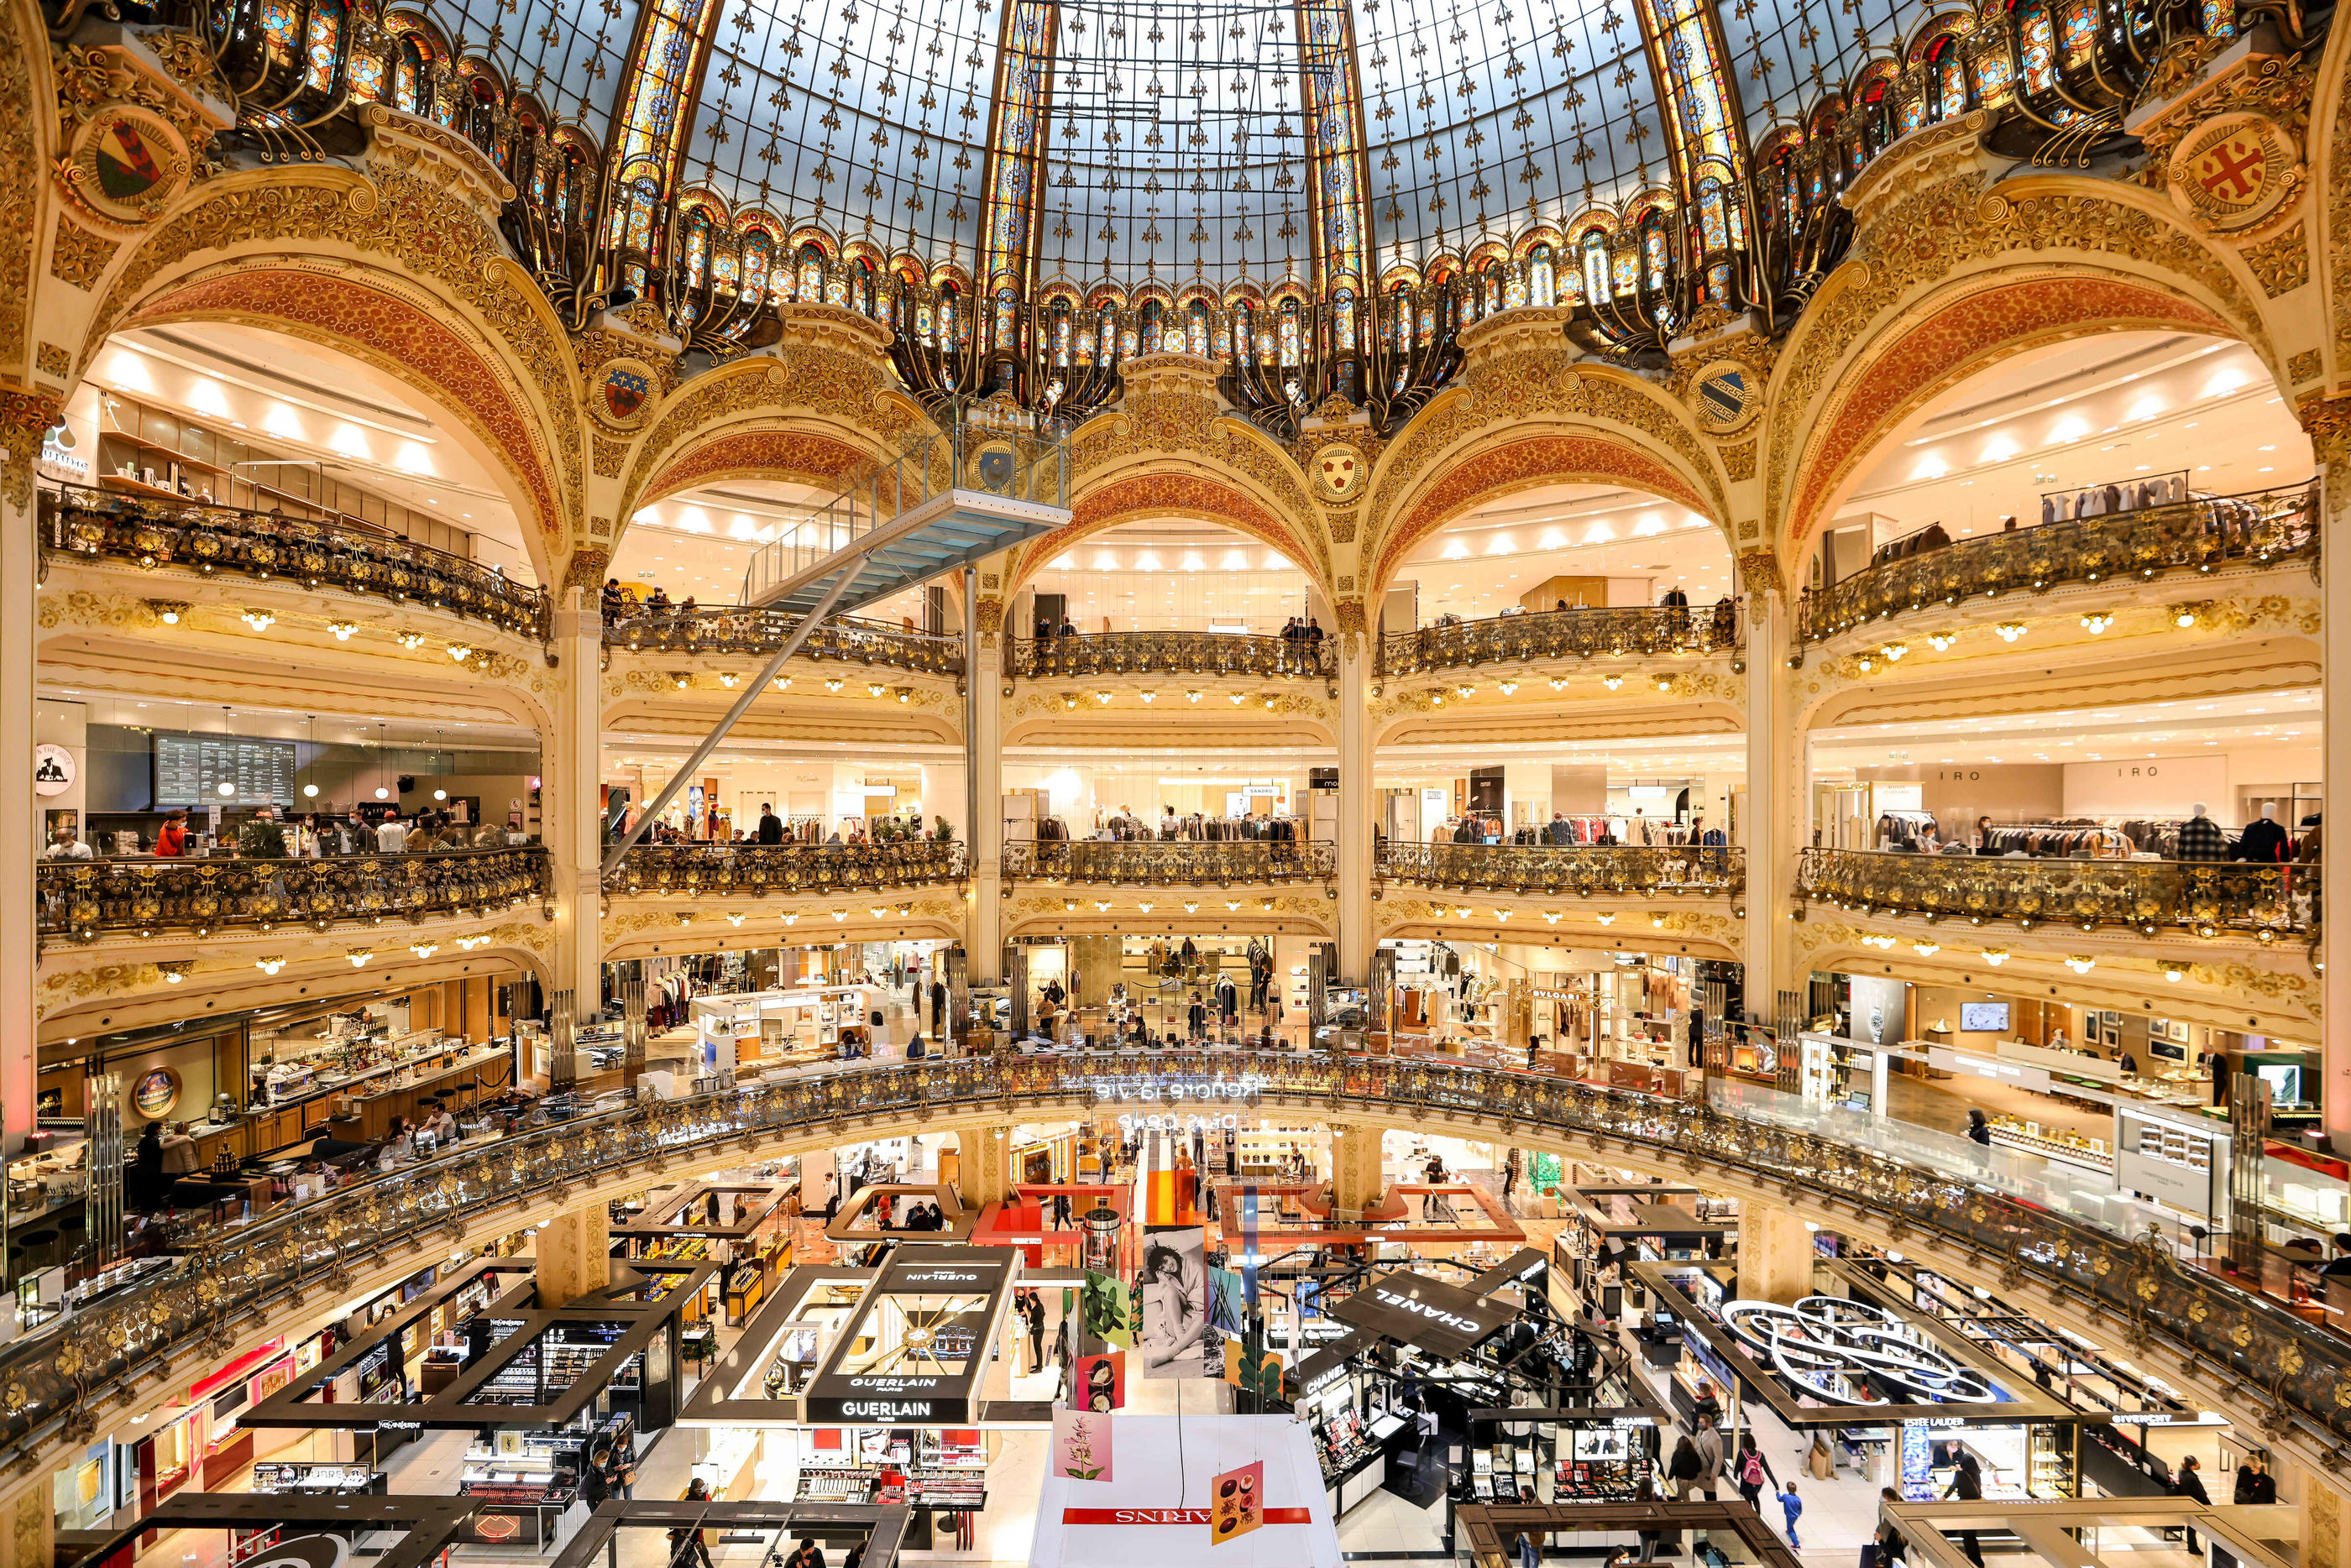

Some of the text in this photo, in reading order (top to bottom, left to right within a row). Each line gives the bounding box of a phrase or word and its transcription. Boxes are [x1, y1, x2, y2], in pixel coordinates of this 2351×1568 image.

[42, 746, 59, 755] THE
[59, 748, 73, 767] JUICE
[1940, 771, 1980, 781] IRO
[2119, 767, 2158, 777] IRO
[1532, 990, 1580, 1001] BVLGARI
[1375, 1288, 1480, 1333] CHANEL
[850, 1377, 937, 1387] GUERLAIN
[1306, 1362, 1347, 1395] CHANEL
[841, 1401, 931, 1417] GUERLAIN
[1612, 1417, 1654, 1426] CHANEL
[1929, 1417, 1966, 1427] LAUDER
[2111, 1414, 2173, 1424] GIVENCHY
[1115, 1510, 1212, 1524] ARINS
